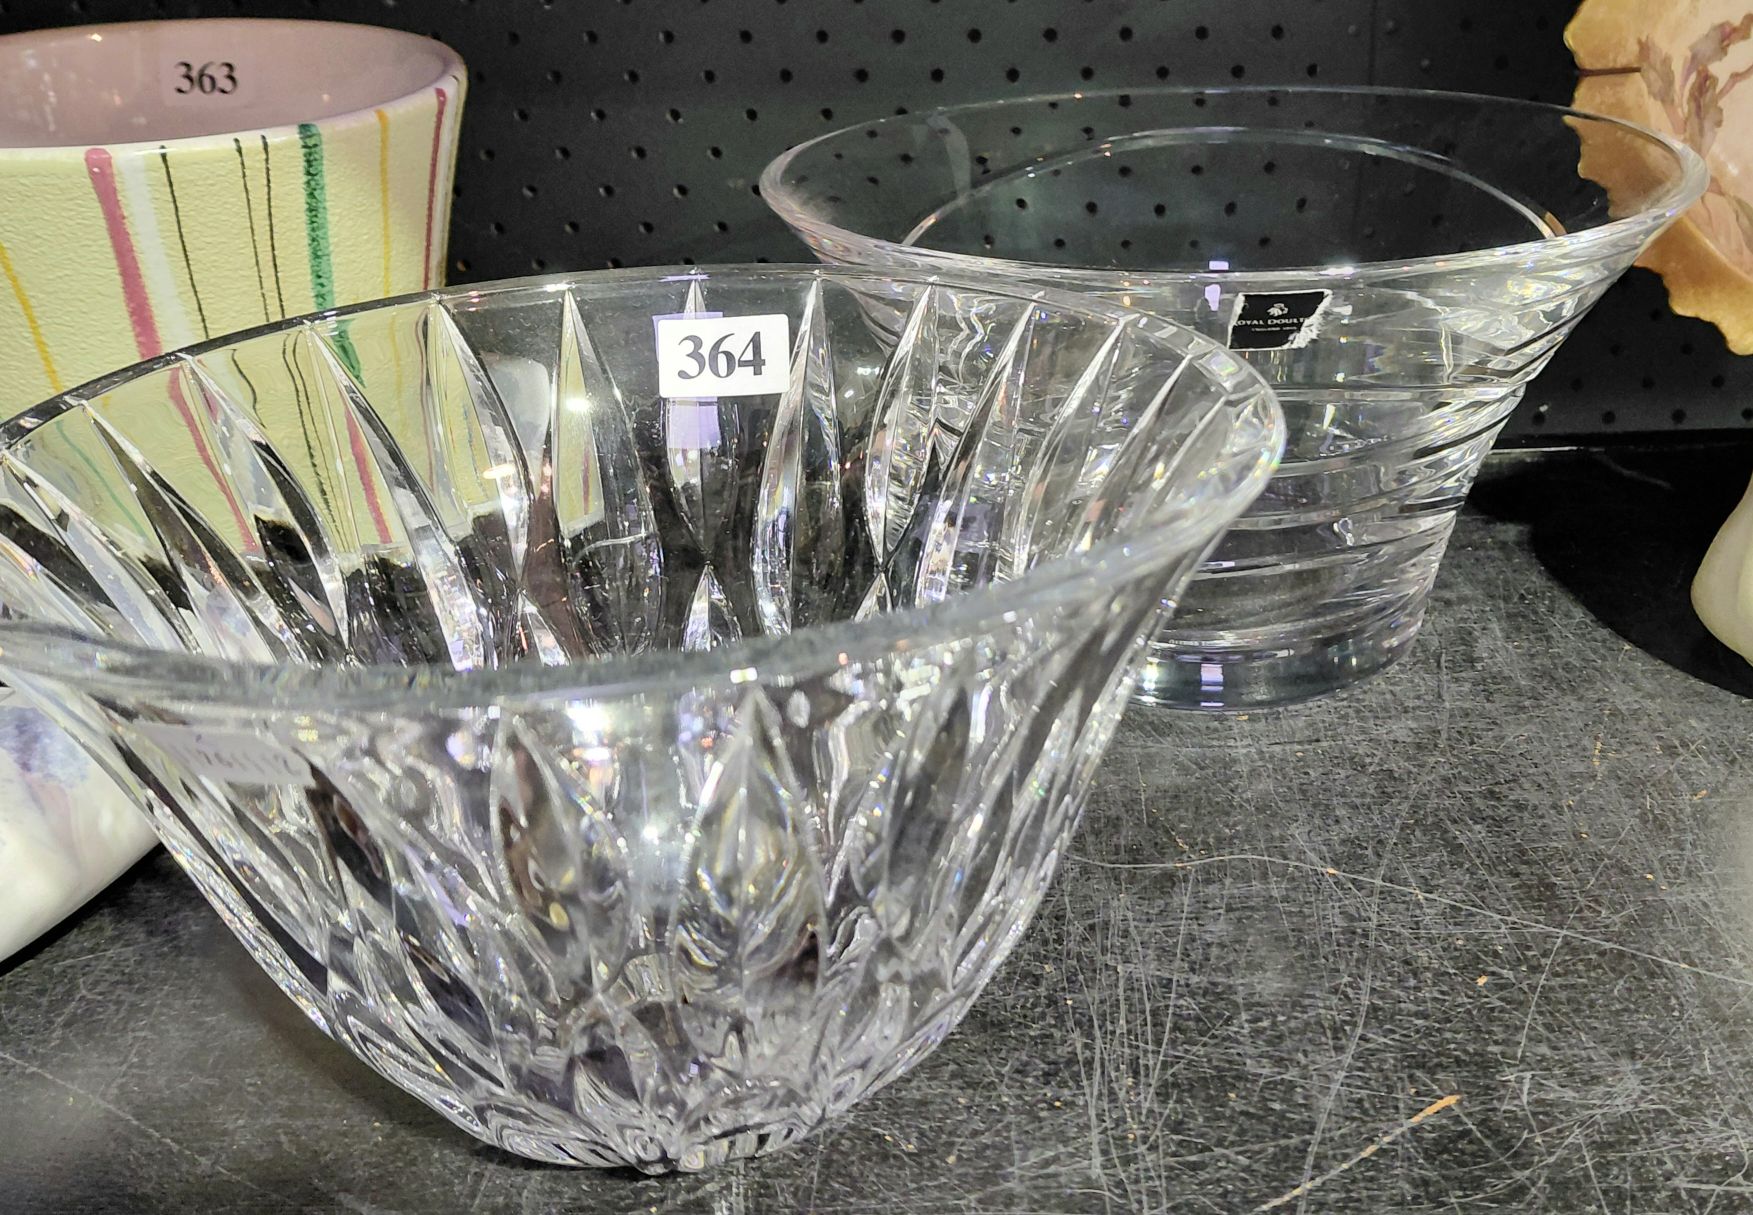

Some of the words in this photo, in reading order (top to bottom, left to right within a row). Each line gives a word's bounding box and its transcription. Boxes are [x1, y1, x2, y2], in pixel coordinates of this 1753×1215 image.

[174, 61, 237, 95] 363
[1267, 317, 1306, 325] DOULT
[677, 331, 766, 380] 364
